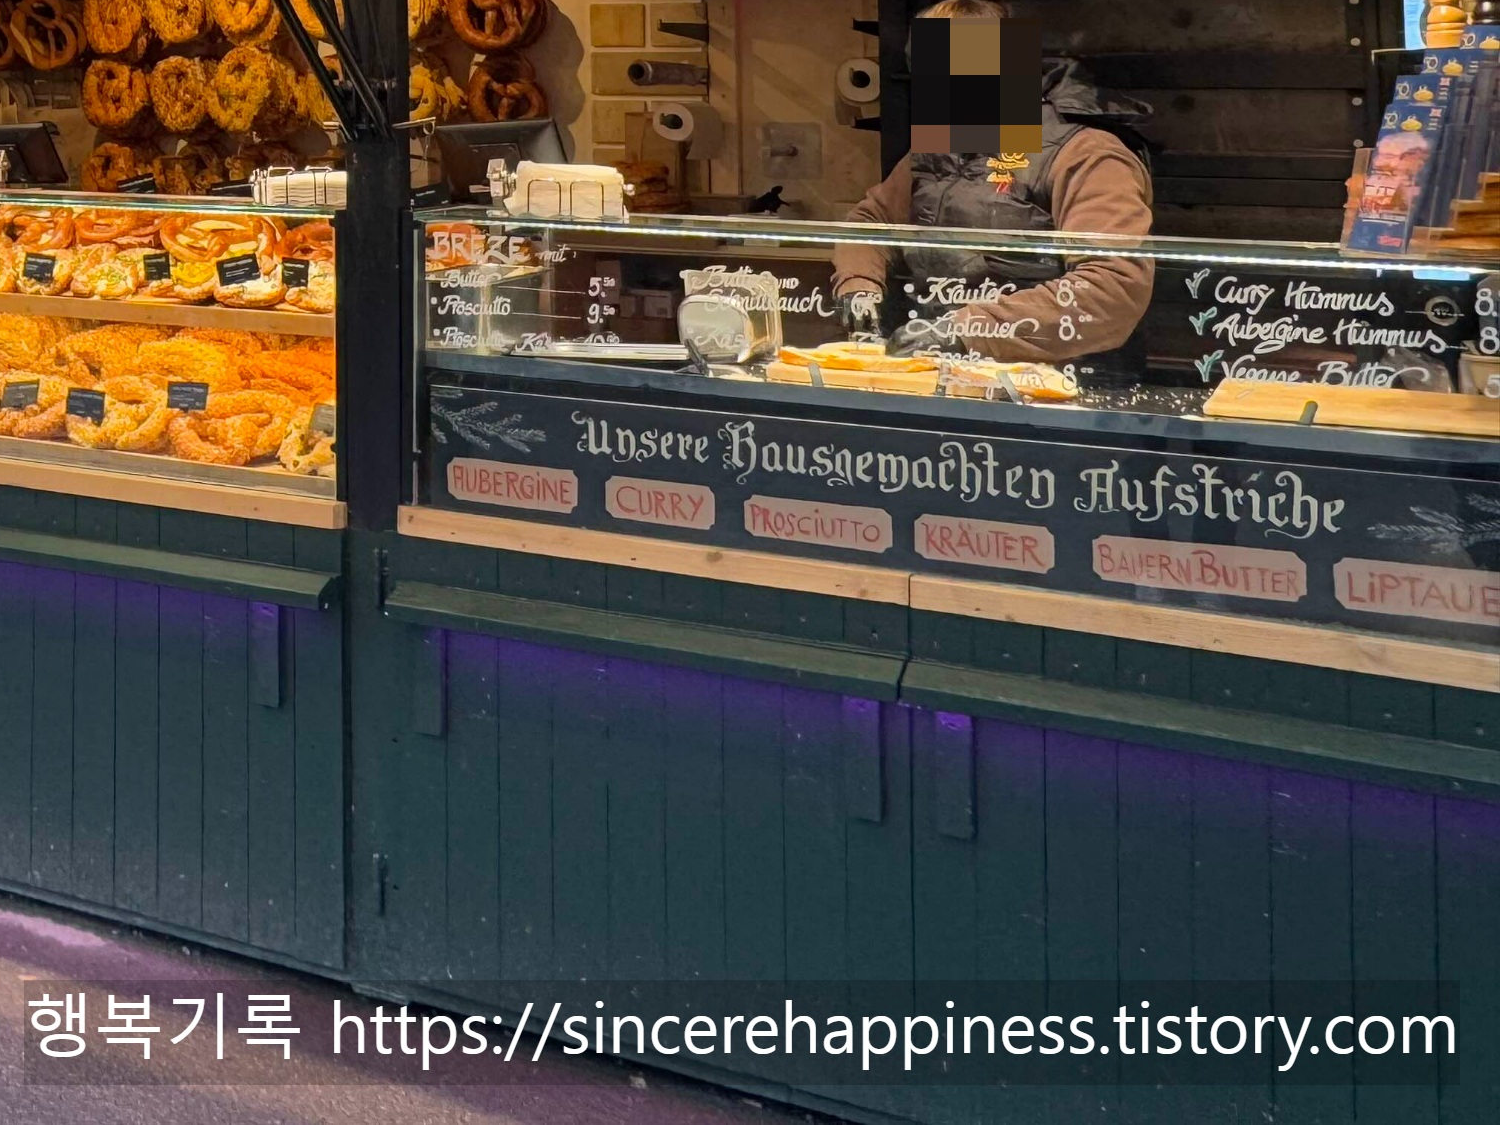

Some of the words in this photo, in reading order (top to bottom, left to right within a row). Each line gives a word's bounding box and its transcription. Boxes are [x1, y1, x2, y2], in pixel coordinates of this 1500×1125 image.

[429, 231, 531, 265] BREZE
[917, 276, 1017, 305] Kräuter
[1214, 276, 1275, 315] Curry
[1284, 281, 1395, 317] Hummus
[906, 310, 1040, 345] Liptauer
[1212, 313, 1327, 353] Aubergine
[1332, 318, 1447, 353] Hummus
[1314, 360, 1429, 388] Butter
[571, 409, 710, 463] Unsere
[718, 420, 1056, 510] Hausgemachten
[1073, 459, 1346, 539] Aufstriche
[615, 484, 704, 523] CURRY
[922, 523, 1045, 567] KRÄUTER
